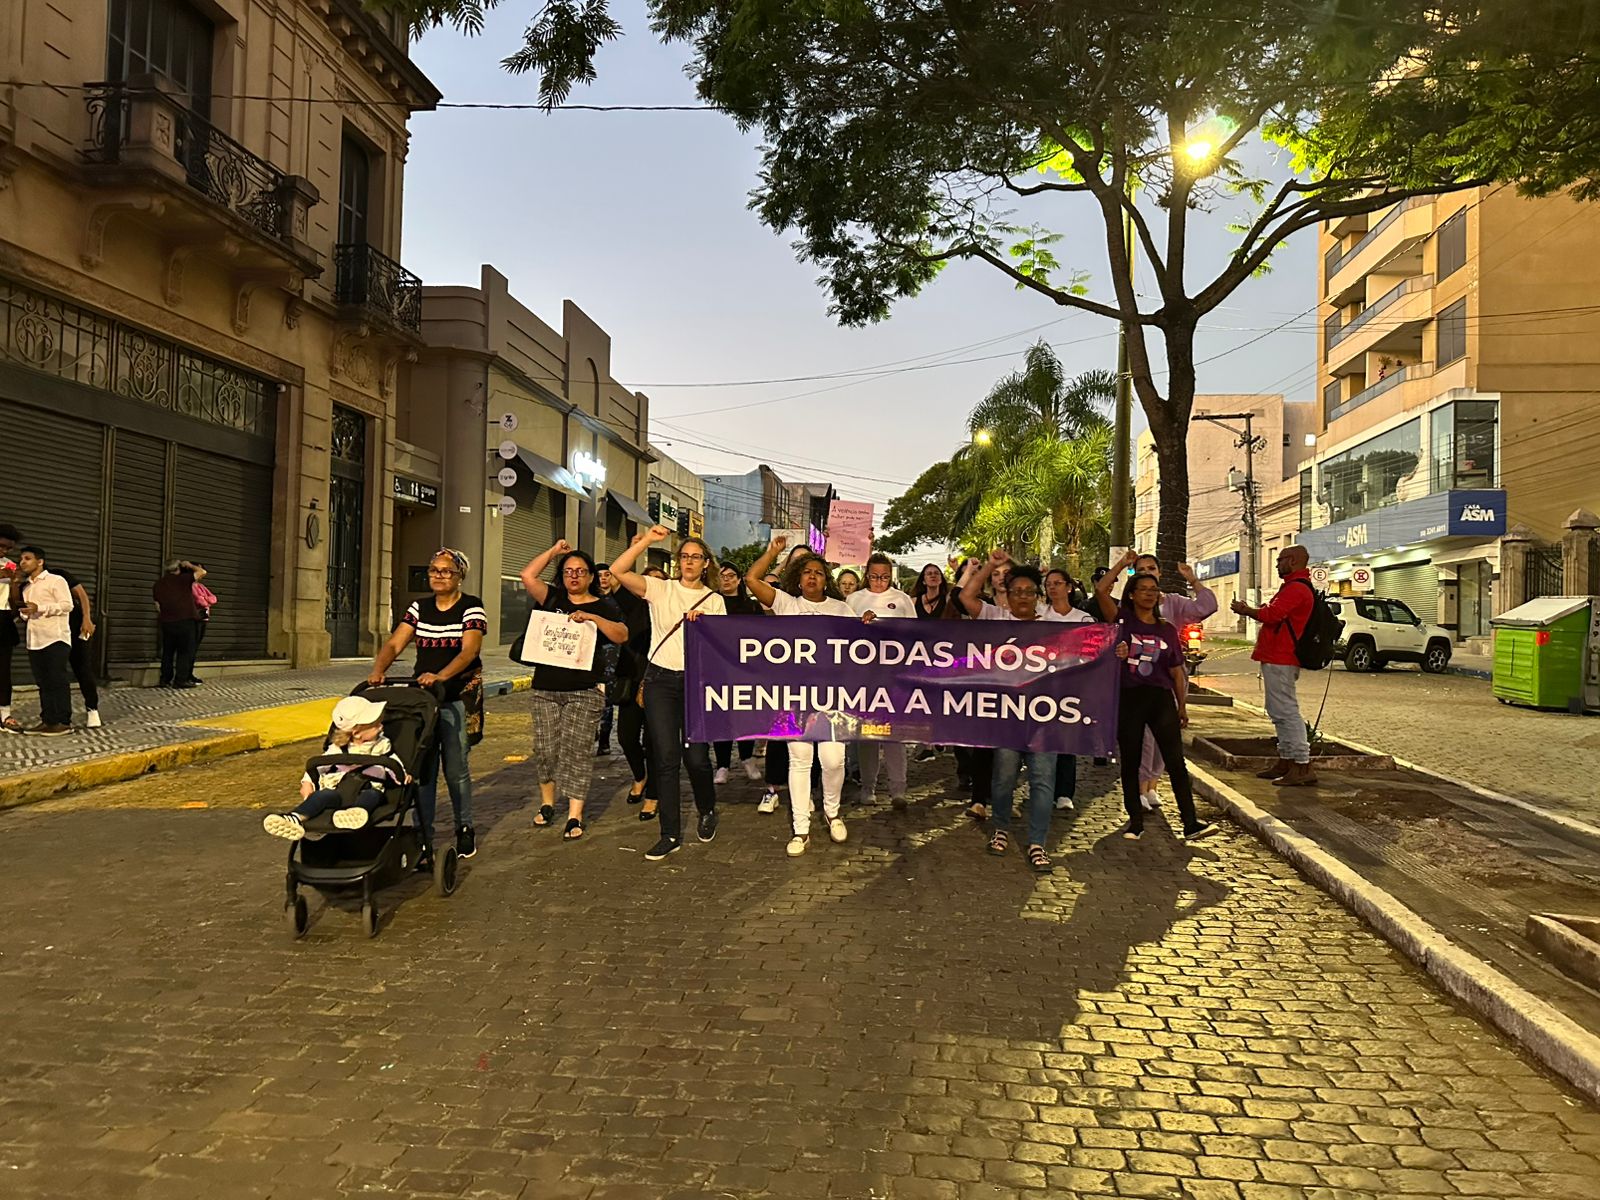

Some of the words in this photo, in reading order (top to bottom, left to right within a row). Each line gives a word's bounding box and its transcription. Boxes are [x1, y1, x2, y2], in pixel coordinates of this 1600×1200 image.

[1460, 509, 1495, 521] ASM
[1345, 523, 1368, 548] ASM
[1317, 571, 1323, 579] E
[739, 638, 817, 664] POR
[827, 638, 954, 668] TODAS
[966, 637, 1057, 674] NÓS:
[705, 685, 895, 713] NENHUMA
[904, 688, 932, 715] A
[943, 690, 1092, 725] MENOS.
[861, 723, 892, 736] BAGÉ
